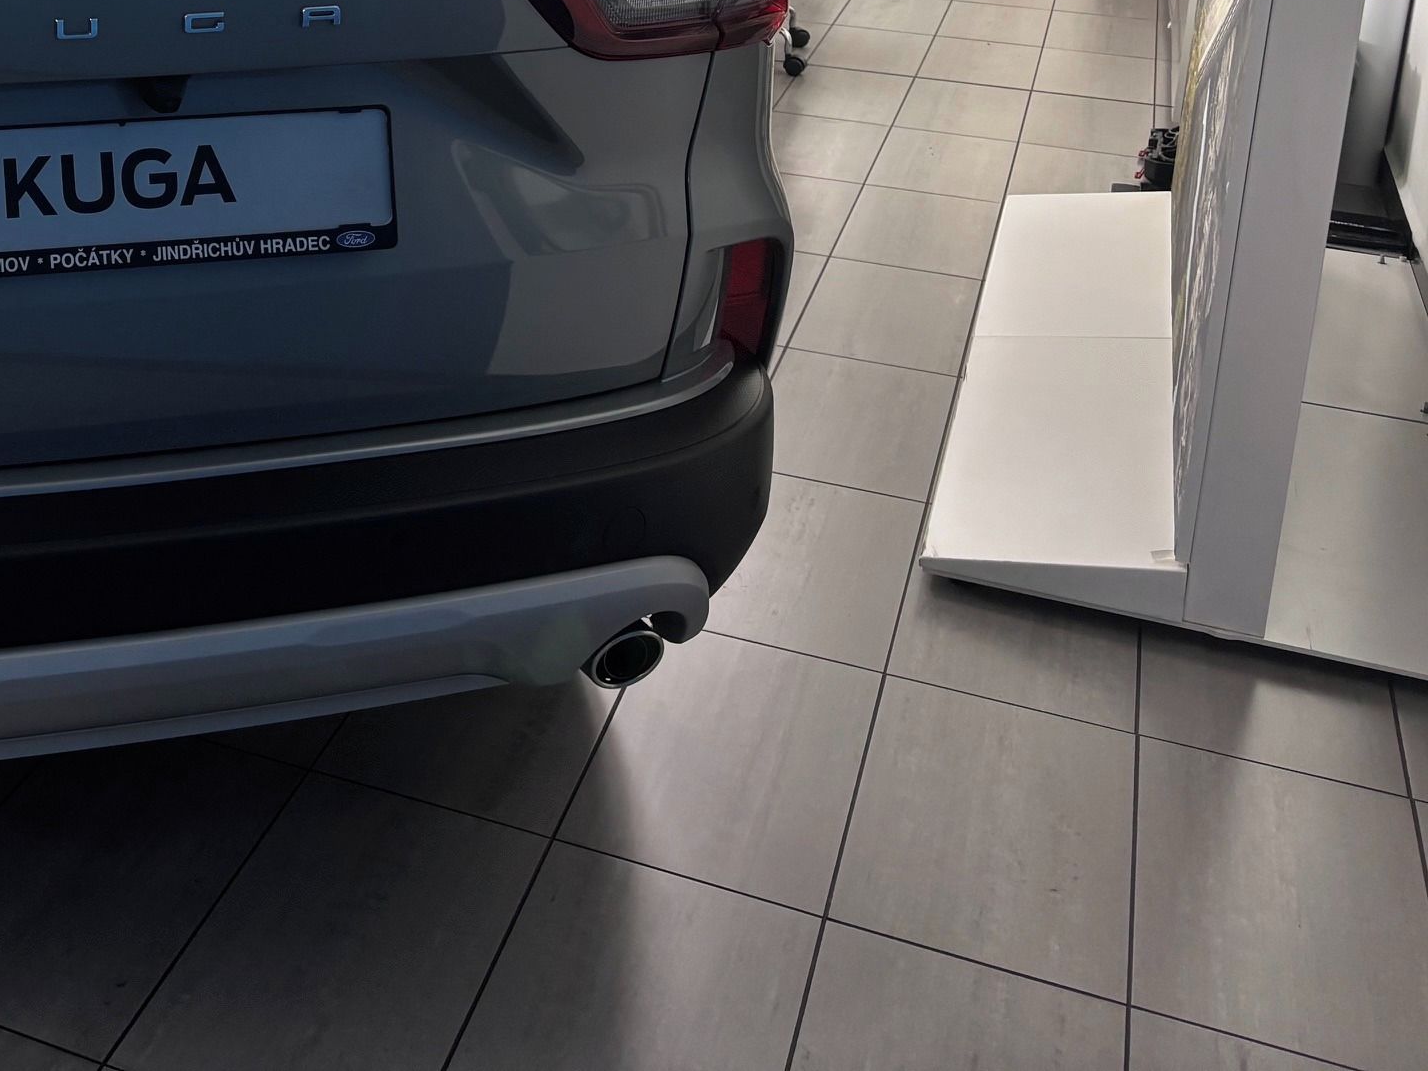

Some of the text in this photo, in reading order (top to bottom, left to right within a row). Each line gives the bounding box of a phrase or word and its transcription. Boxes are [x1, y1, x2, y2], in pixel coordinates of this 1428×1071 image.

[3, 144, 237, 219] KUGA
[50, 247, 133, 269] POČÁTKY
[152, 237, 255, 262] JINDŘICHŮV
[260, 235, 332, 254] HRADEC
